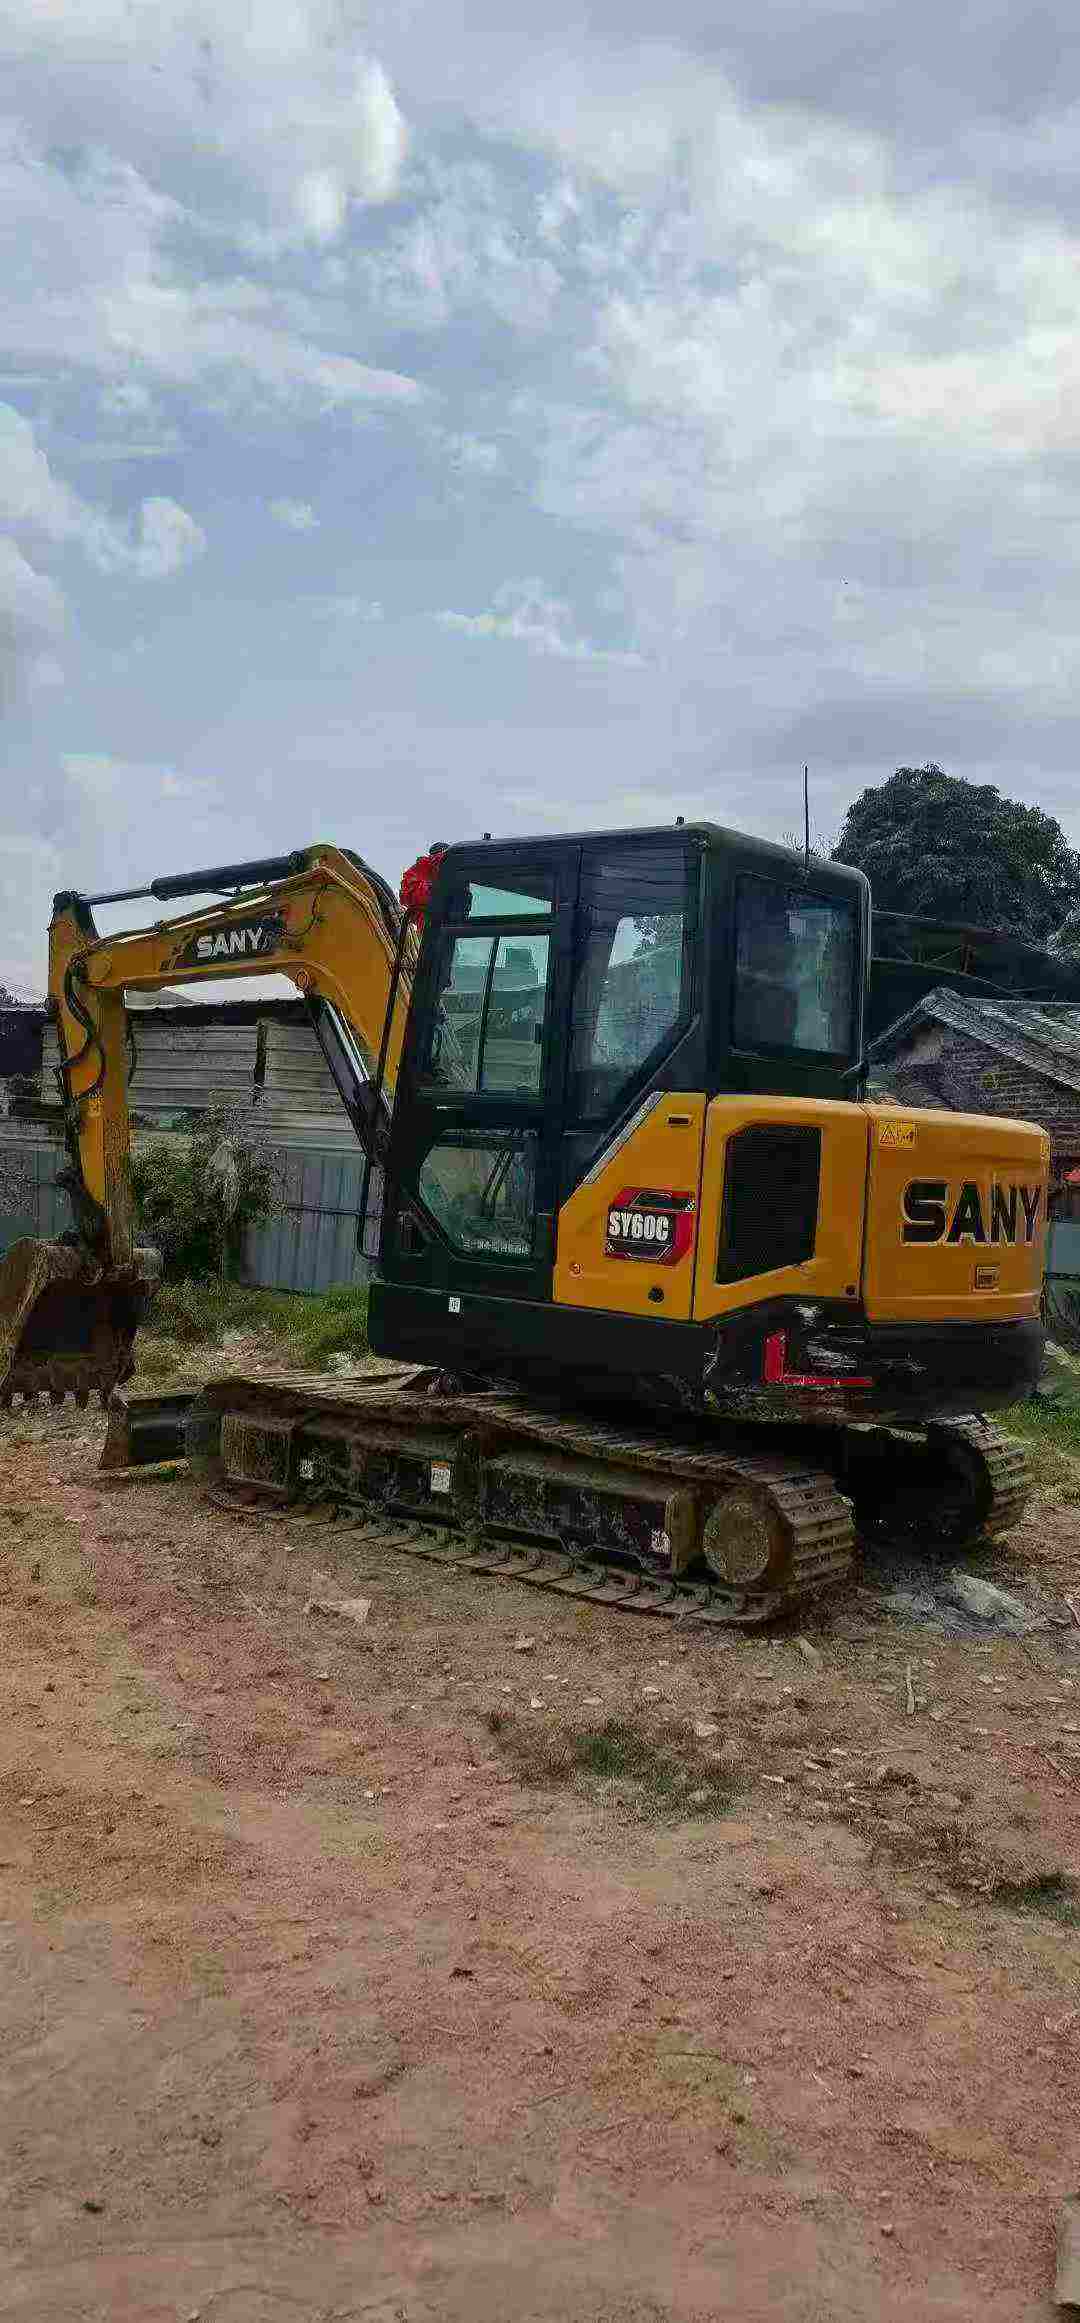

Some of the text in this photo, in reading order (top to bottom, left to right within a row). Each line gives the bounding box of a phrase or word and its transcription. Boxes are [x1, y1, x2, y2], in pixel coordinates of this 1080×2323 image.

[197, 927, 263, 959] SANY
[608, 1210, 669, 1241] SY60C
[901, 1178, 1043, 1246] SANY
